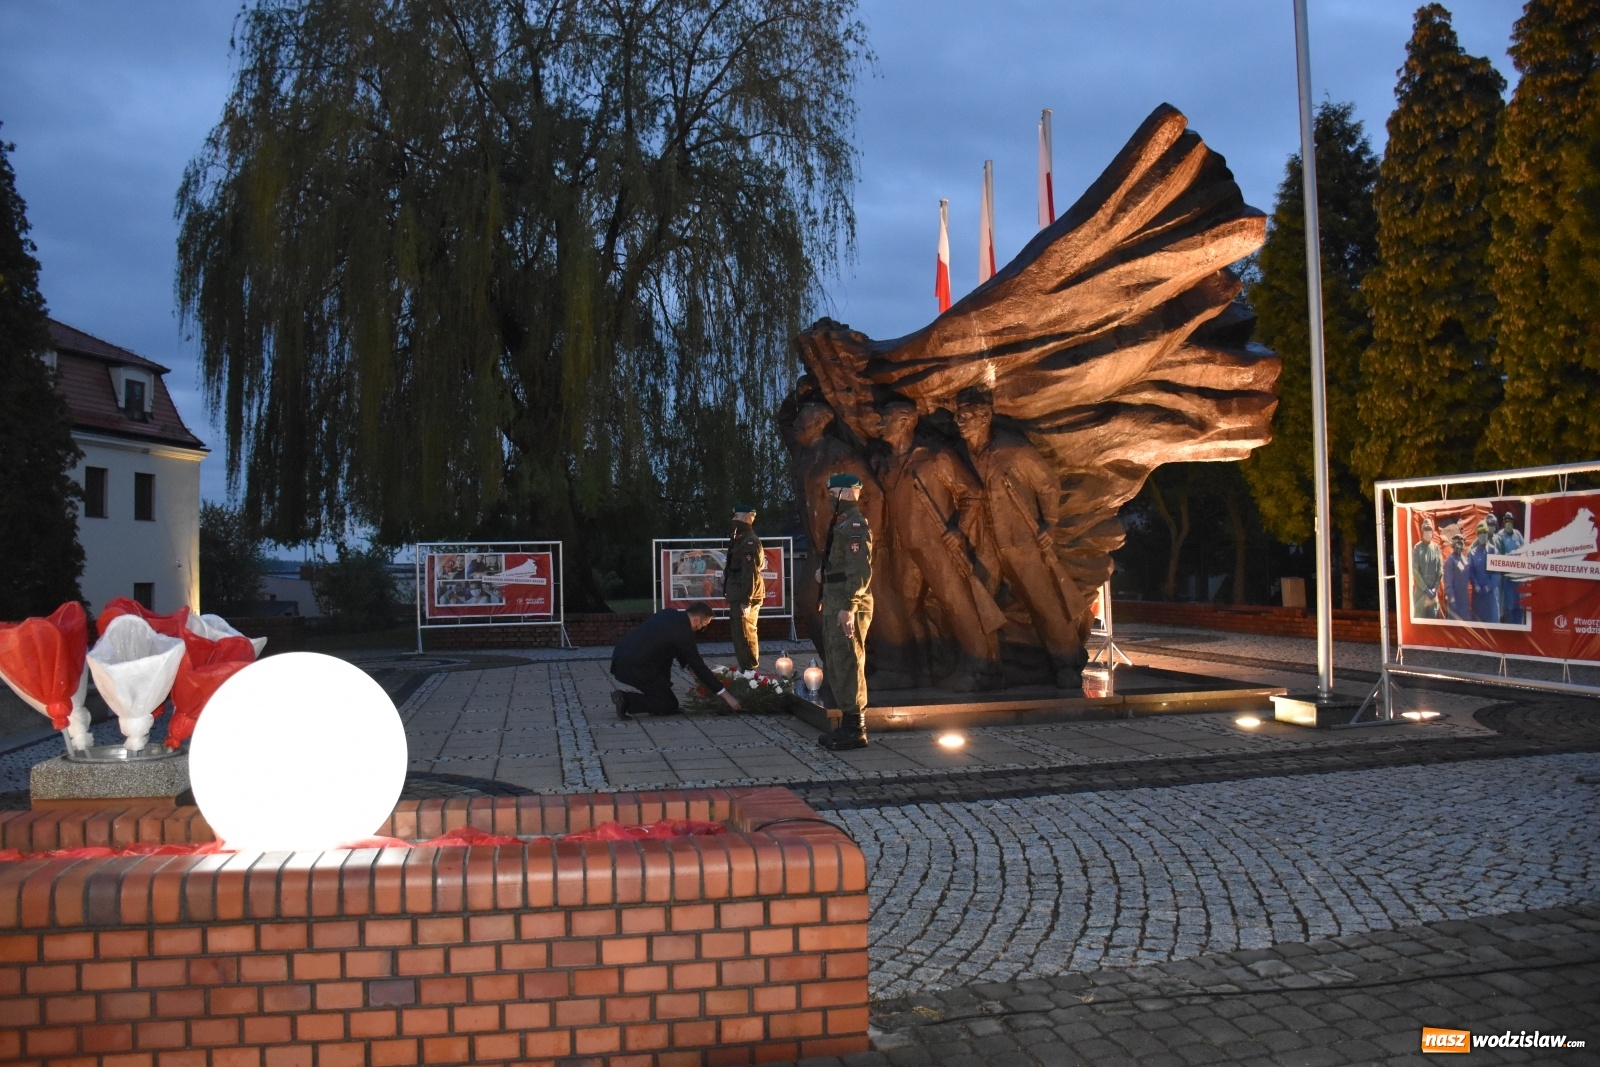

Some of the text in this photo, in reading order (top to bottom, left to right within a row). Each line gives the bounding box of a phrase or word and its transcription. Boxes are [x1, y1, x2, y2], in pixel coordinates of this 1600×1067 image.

[1536, 549, 1549, 558] maja
[1490, 559, 1526, 569] NIEBAWEM
[1527, 561, 1549, 571] ZNÓW
[1550, 563, 1588, 574] BĘDZIEMY
[1574, 617, 1600, 627] #tworz
